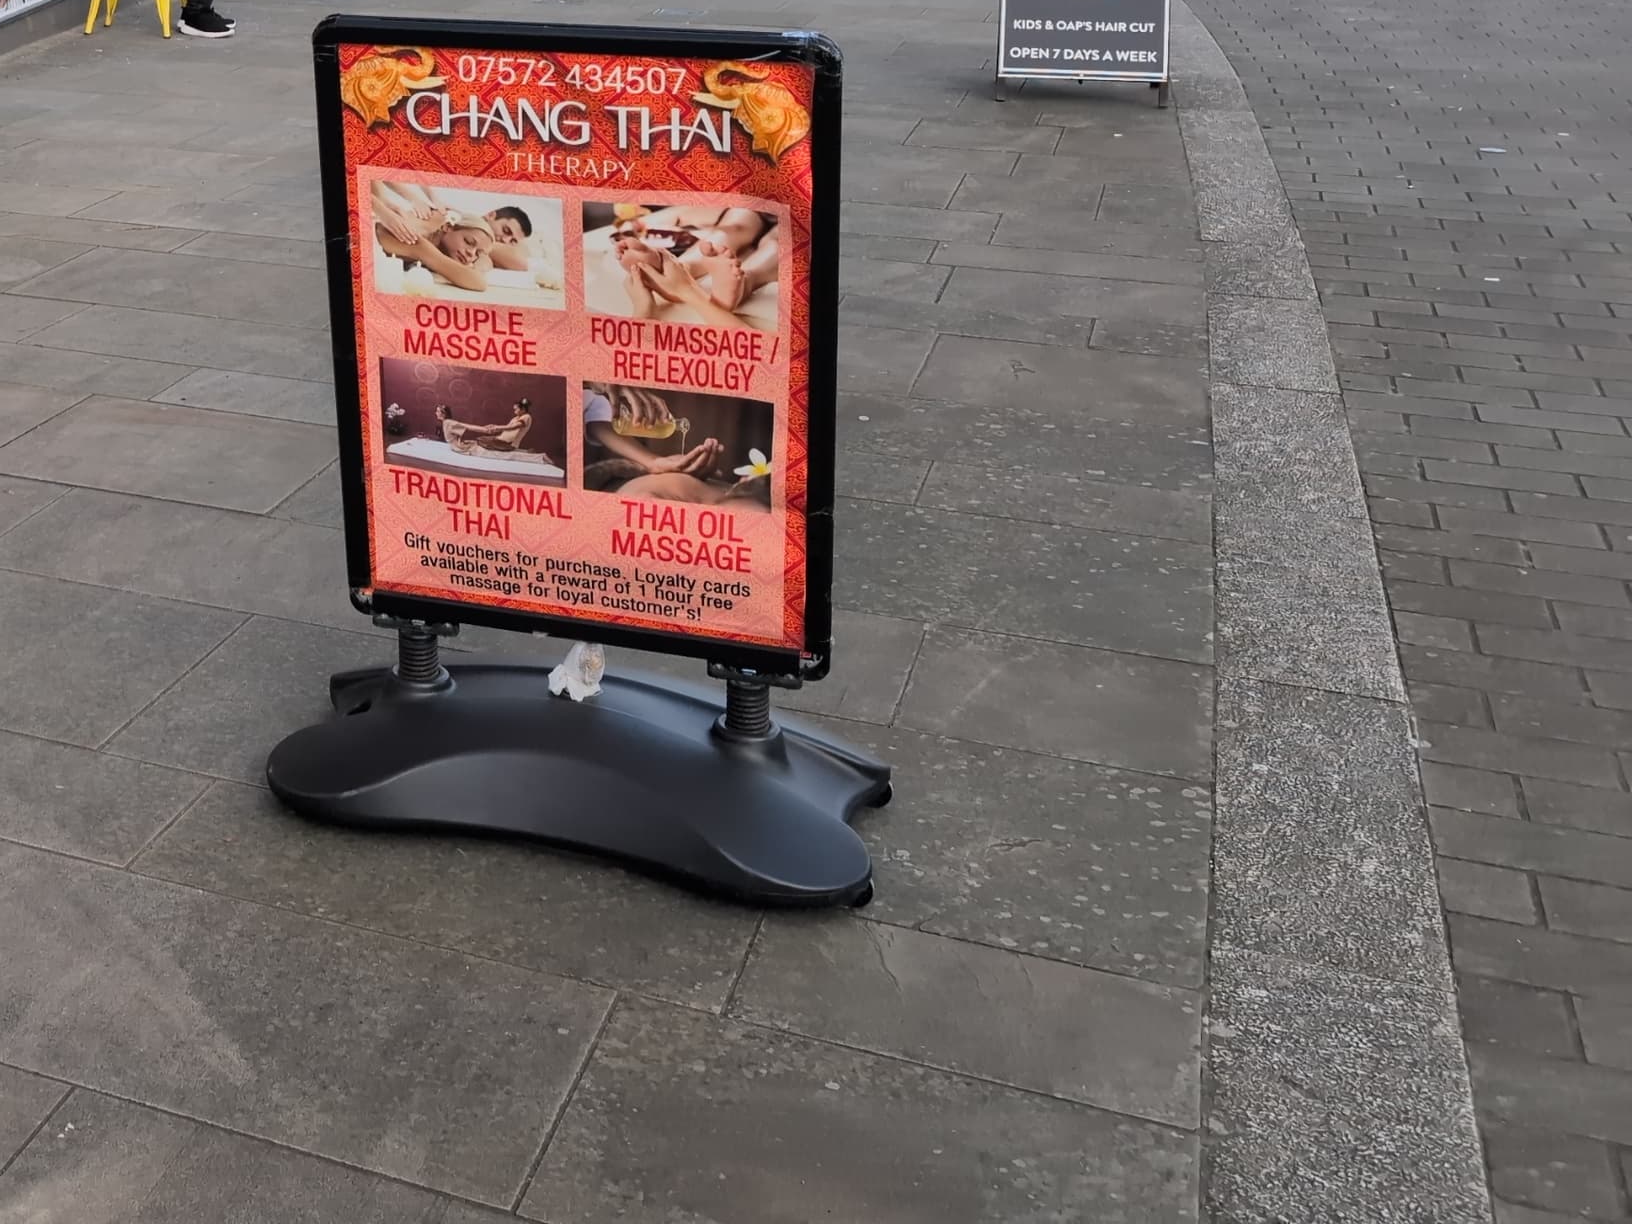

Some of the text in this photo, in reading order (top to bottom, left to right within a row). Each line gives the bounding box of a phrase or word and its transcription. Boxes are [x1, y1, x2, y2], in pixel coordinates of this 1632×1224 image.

[1013, 19, 1156, 33] KIDS & OAP'S HAIR CUT
[458, 55, 686, 95] 07572 434507
[1009, 47, 1158, 63] OPEN 7 DAYS A WEEK
[406, 91, 731, 153] CHANG THAI
[506, 152, 636, 180] THERAPY
[415, 303, 524, 337] COUPLE
[591, 317, 646, 349] FOOT
[654, 323, 763, 362] MASSAGE
[403, 329, 537, 366] MASSAGE
[614, 350, 755, 392] REFLEXOLGY
[389, 468, 572, 520] TRADITIONAL
[447, 507, 510, 540] THAI
[621, 500, 744, 543] THAI OIL
[404, 532, 751, 598] Gift vouchers for purchase. Loyalty cards
[611, 530, 752, 574] MASSAGE
[420, 554, 733, 611] available with a reward of 1 hour free
[450, 572, 702, 621] massage for loyal customer's!
